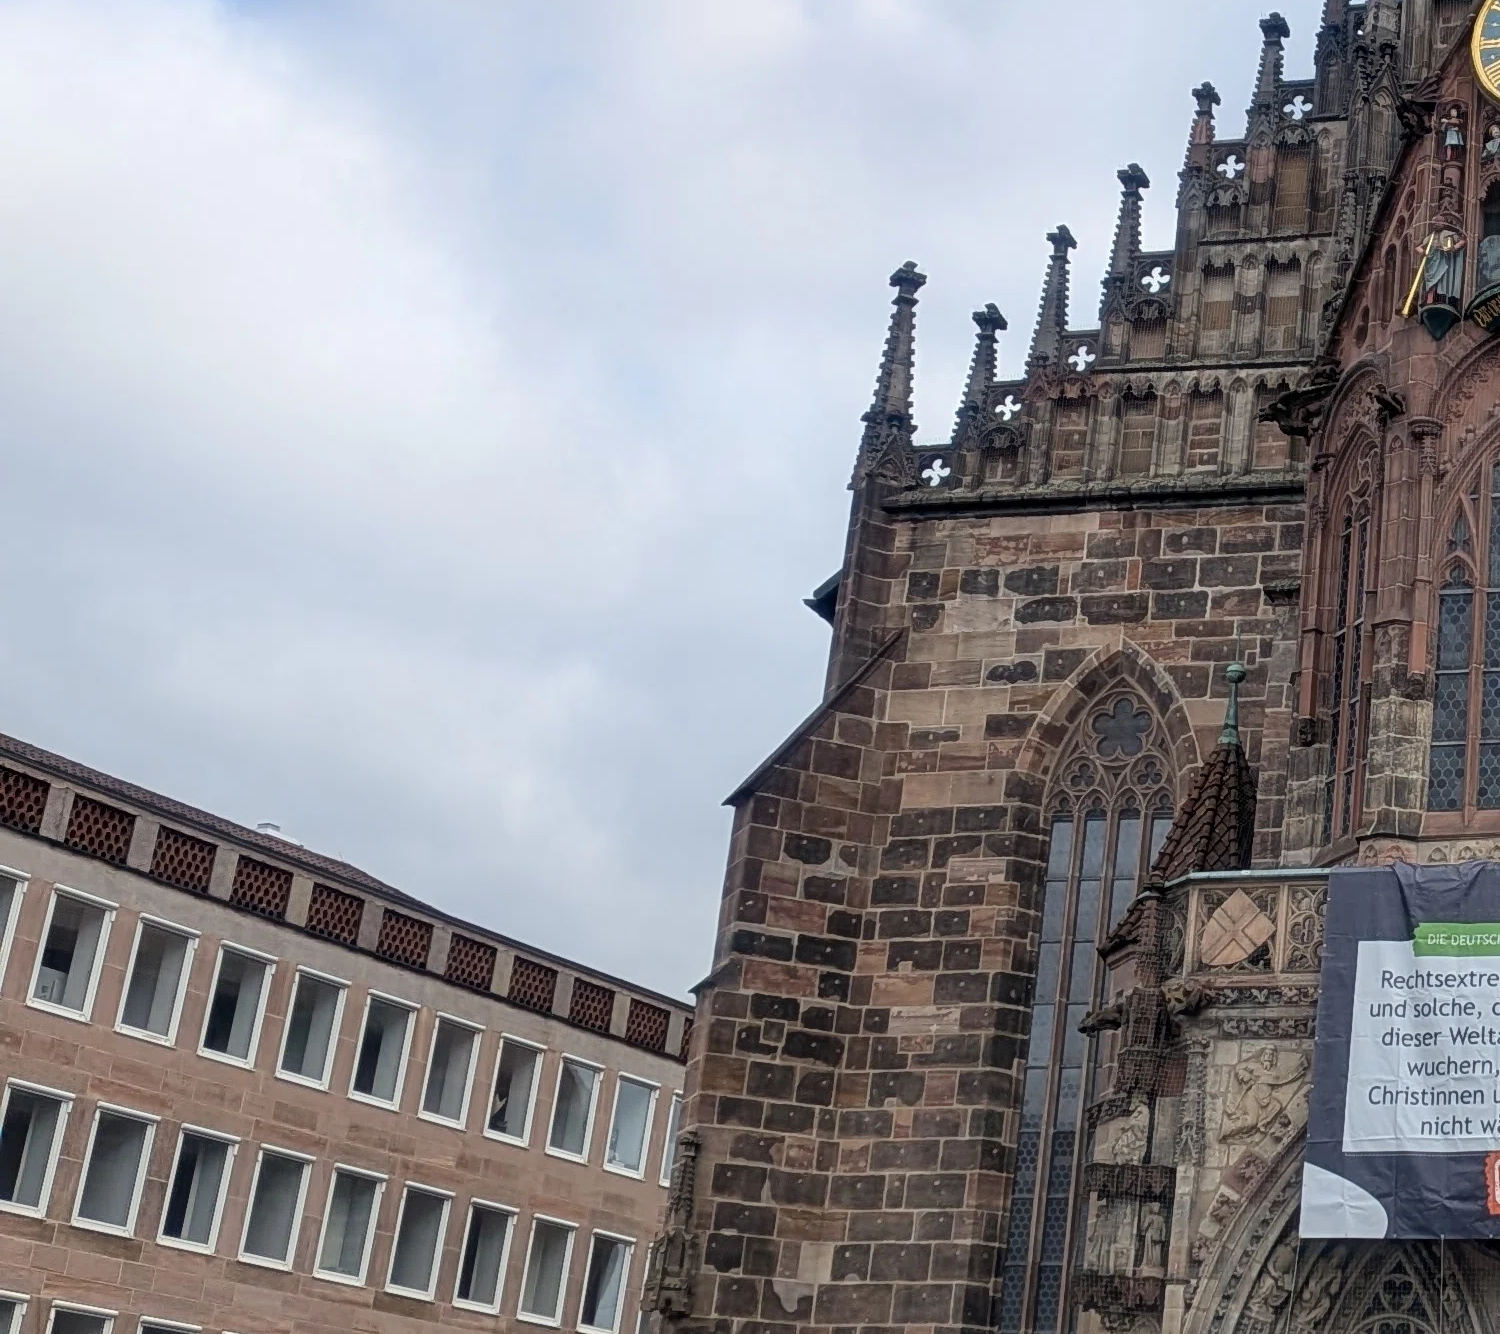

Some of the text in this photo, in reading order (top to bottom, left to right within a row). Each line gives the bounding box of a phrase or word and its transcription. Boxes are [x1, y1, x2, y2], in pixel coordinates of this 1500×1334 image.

[1427, 933, 1448, 945] DIE
[1370, 1001, 1406, 1018] und
[1413, 997, 1483, 1019] solche,
[1381, 1027, 1443, 1047] dieser
[1407, 1056, 1500, 1077] wuchern,
[1368, 1085, 1485, 1106] Christinnen
[1420, 1115, 1472, 1136] nicht
